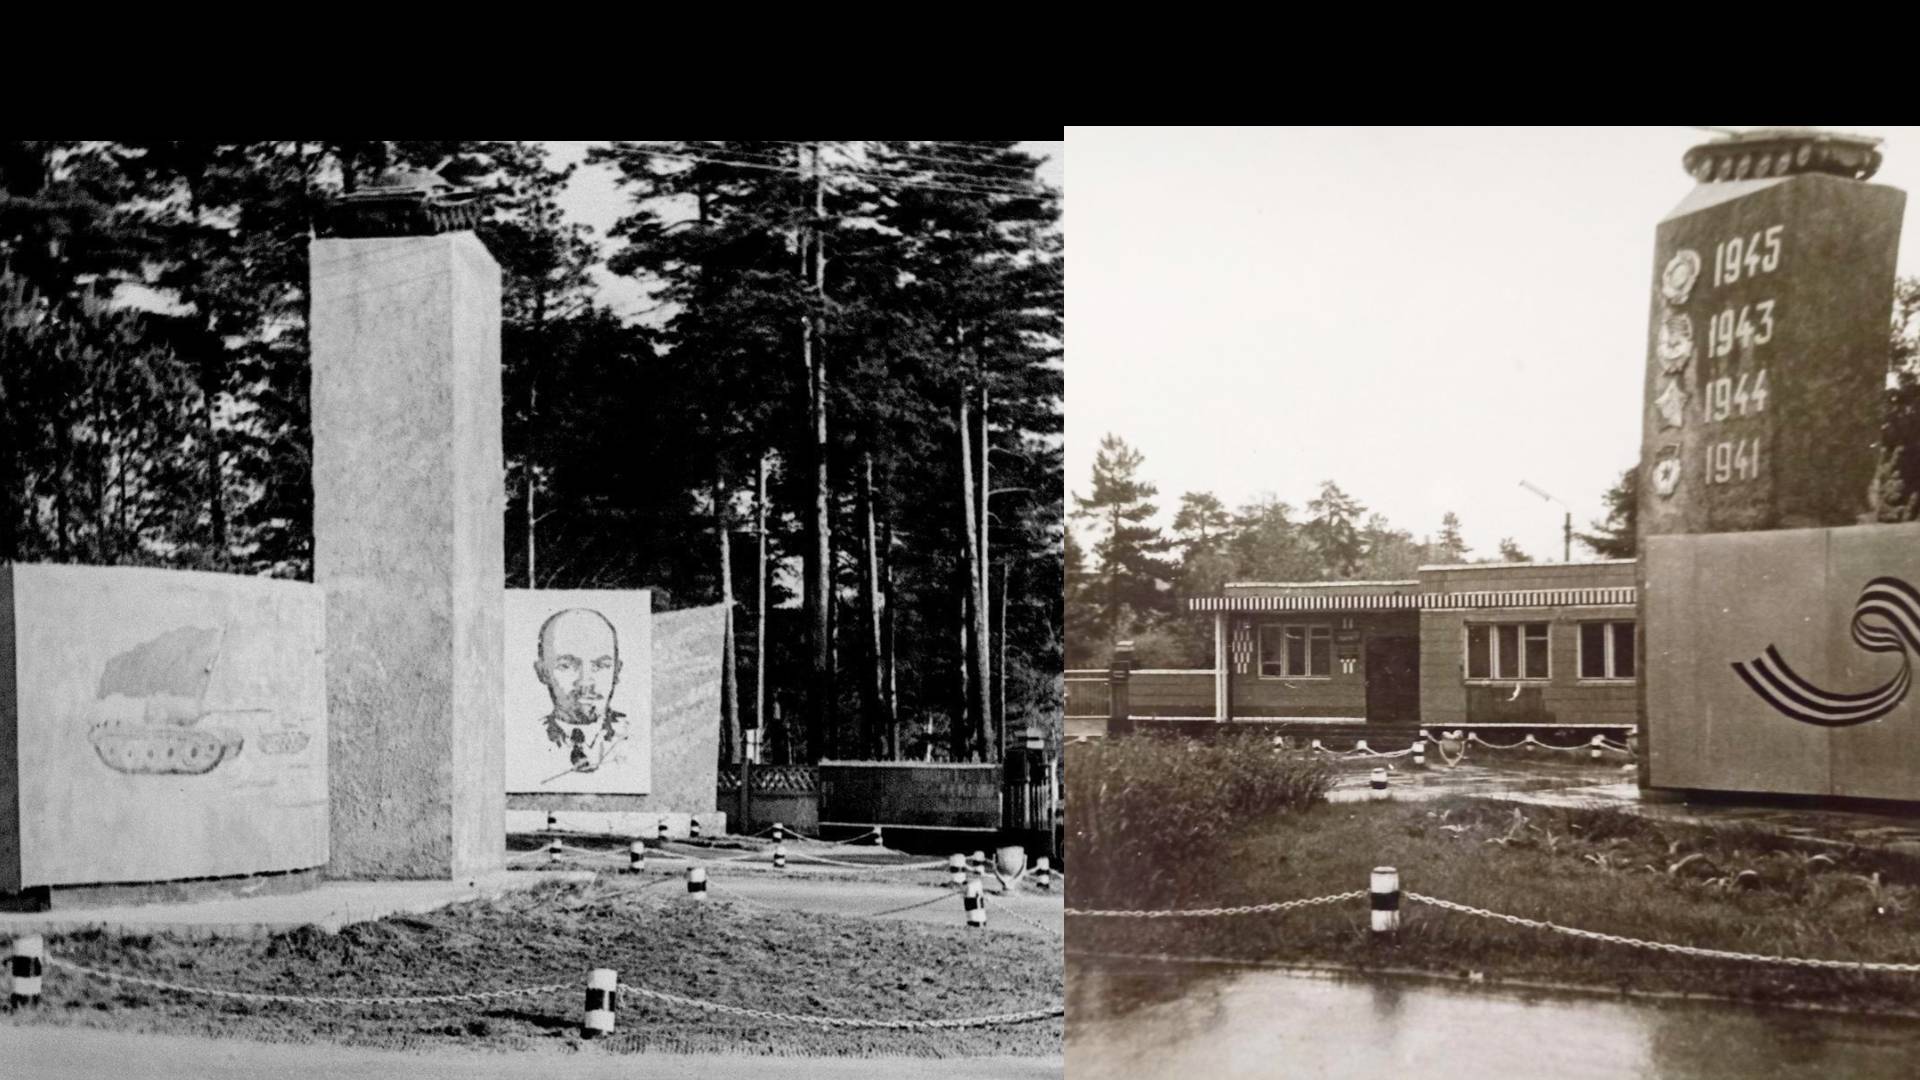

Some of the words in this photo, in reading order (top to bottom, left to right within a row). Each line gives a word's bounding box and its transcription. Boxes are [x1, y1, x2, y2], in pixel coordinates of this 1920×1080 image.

[1714, 225, 1784, 288] 1945
[1708, 299, 1776, 358] 1943
[1704, 369, 1768, 423] 1944
[1705, 438, 1759, 484] 1941
